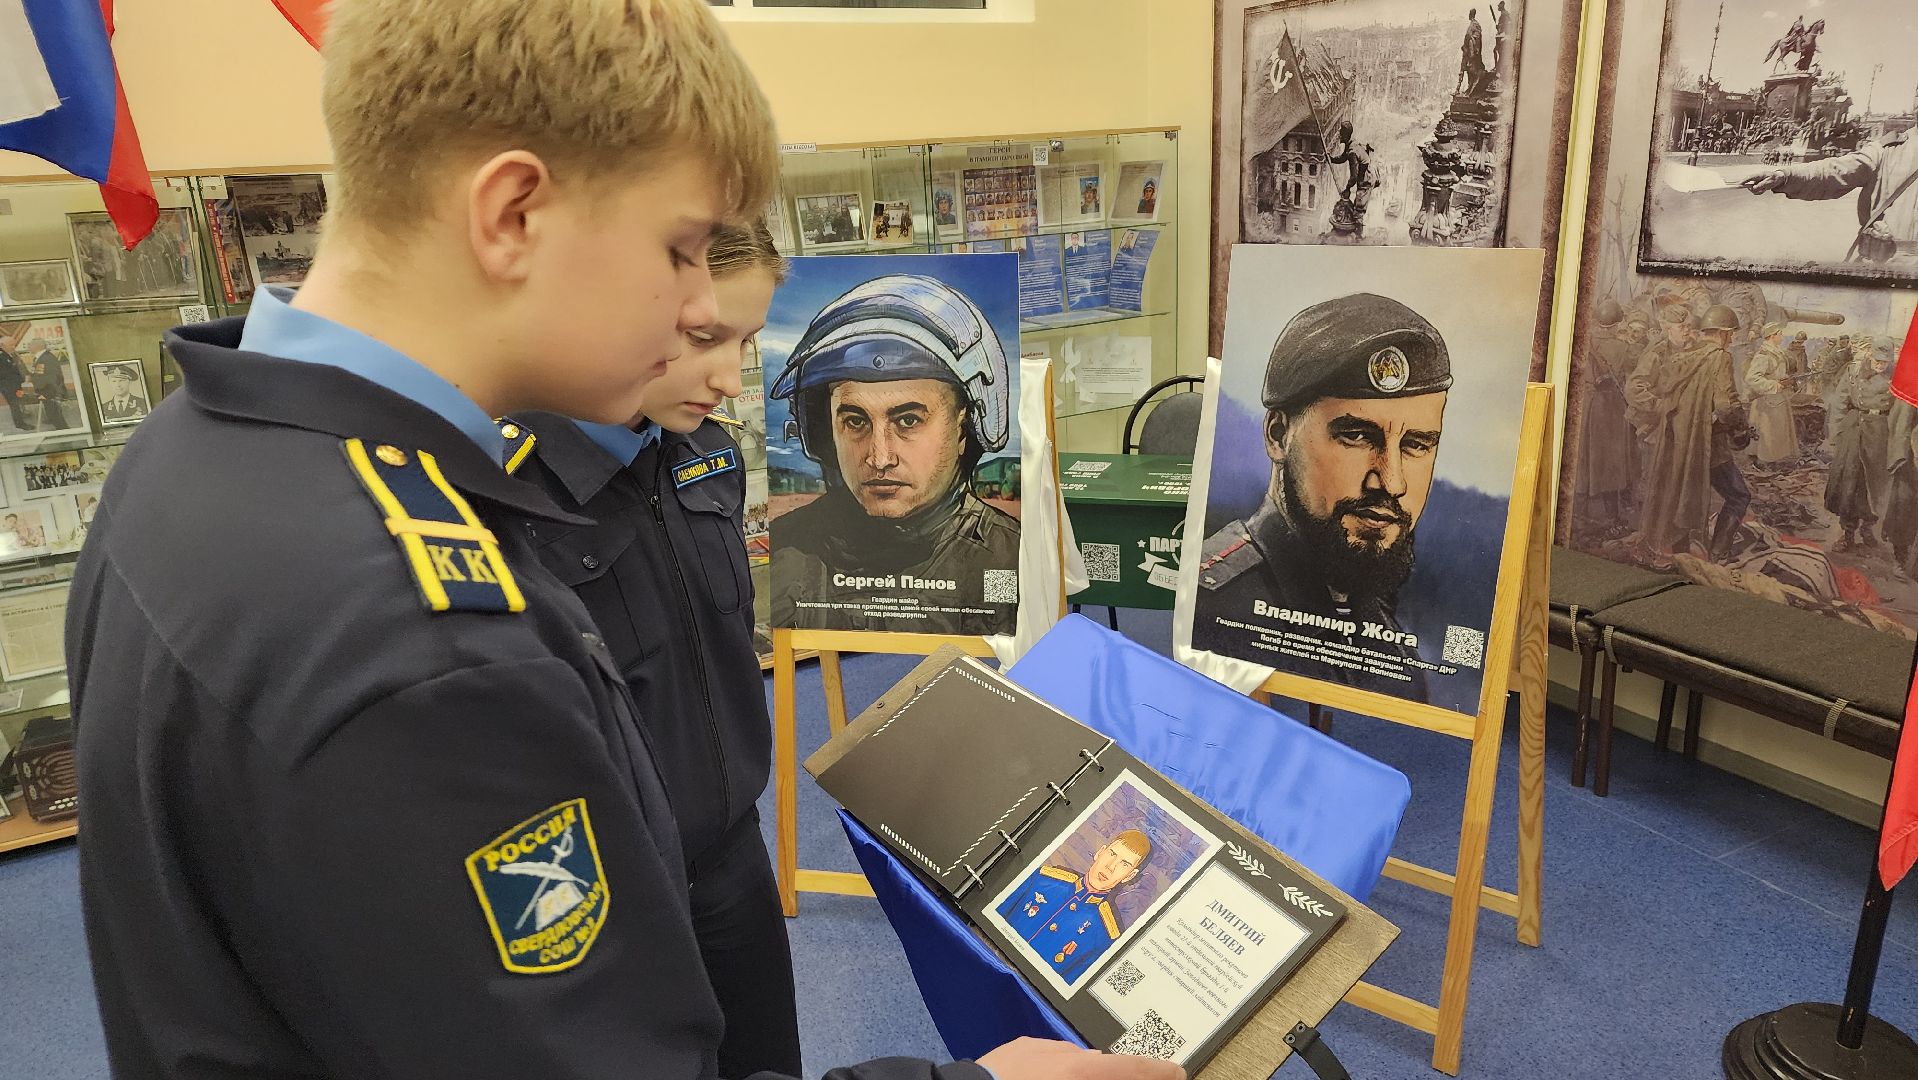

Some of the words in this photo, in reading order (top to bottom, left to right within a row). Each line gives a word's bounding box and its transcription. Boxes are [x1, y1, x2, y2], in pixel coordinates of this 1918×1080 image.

[1149, 536, 1183, 553] ПАР
[833, 572, 896, 590] Сергей
[900, 575, 957, 591] Панов
[1253, 599, 1356, 637] Владимир
[1361, 621, 1418, 648] Жога
[1215, 616, 1244, 629] Гвардии
[1323, 640, 1361, 654] командир
[1361, 647, 1402, 663] батальона
[1438, 665, 1458, 675] ДНР
[1251, 641, 1279, 652] мирных
[1280, 648, 1310, 659] жителей
[1320, 655, 1362, 670] Мариуполя
[1260, 633, 1282, 645] Погиб
[1282, 639, 1292, 647] во
[1315, 646, 1364, 663] обеспечения
[1364, 657, 1404, 672] эвакуации
[482, 806, 577, 872] РОССИЯ
[1199, 917, 1245, 956] БЕЛЯЕВ
[1206, 900, 1266, 946] ДМИТРИЙ
